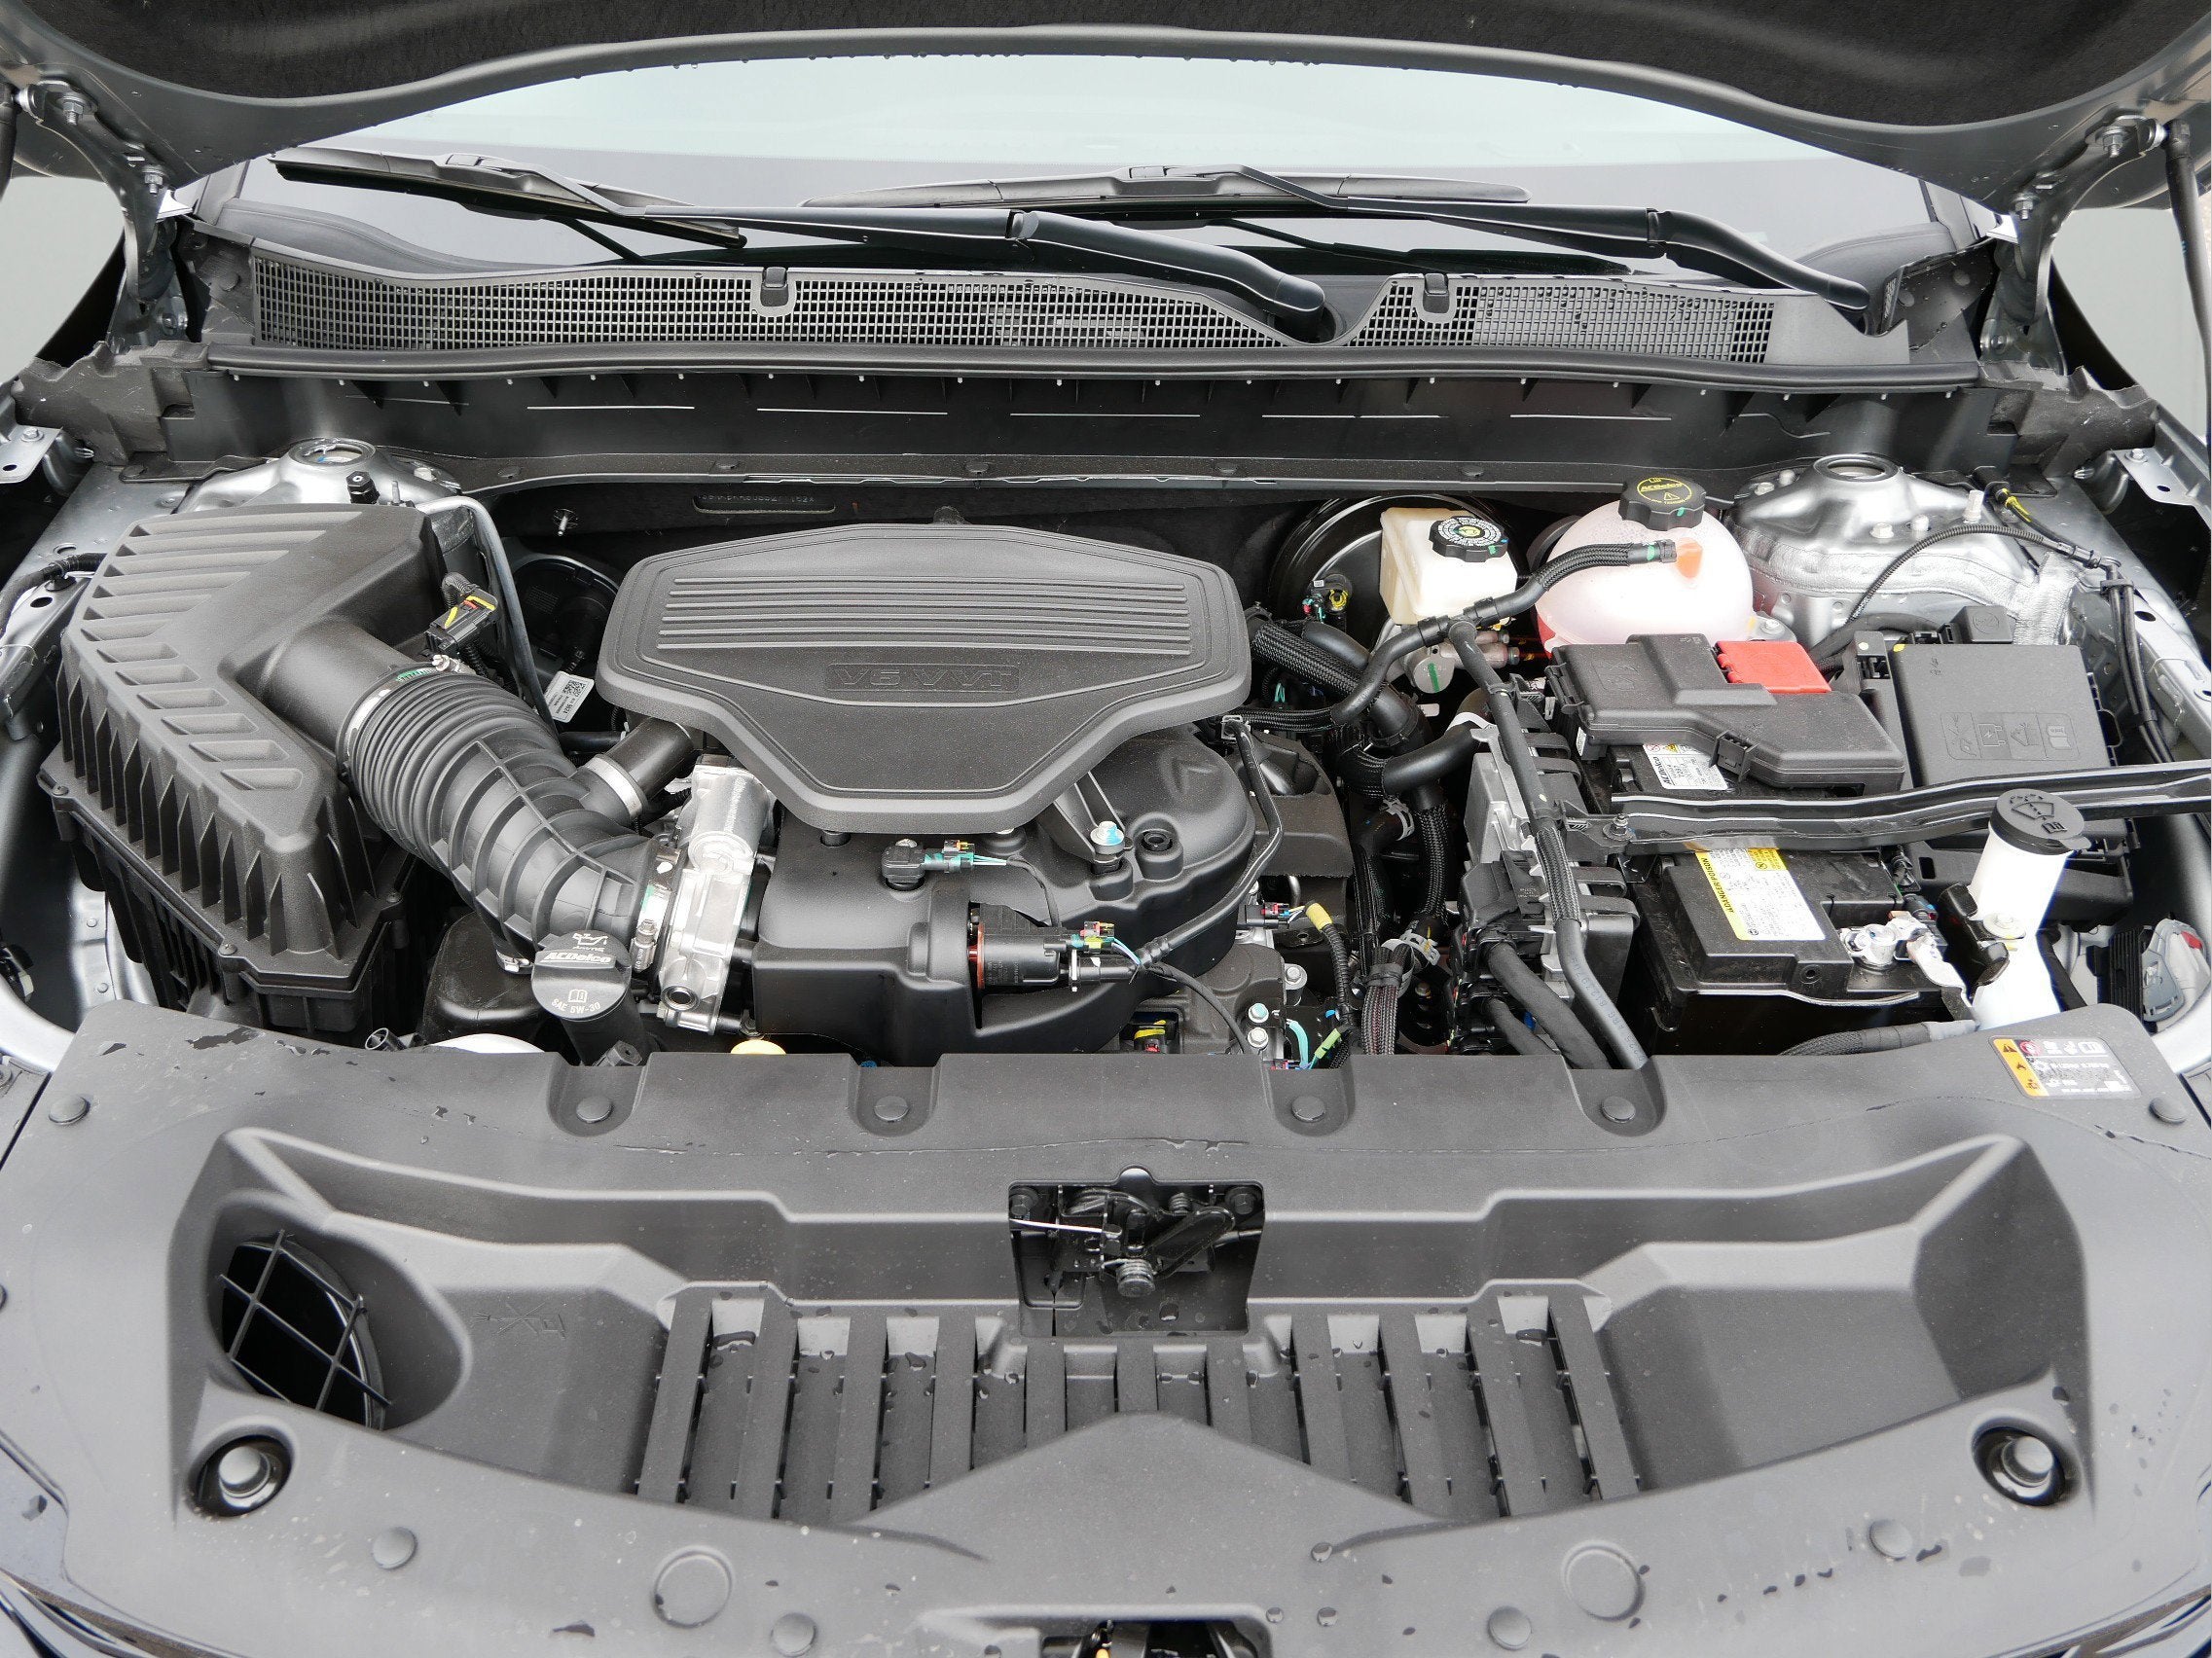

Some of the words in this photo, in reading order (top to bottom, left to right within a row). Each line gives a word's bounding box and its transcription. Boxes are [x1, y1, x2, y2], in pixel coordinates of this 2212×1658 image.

[835, 667, 900, 686] V6
[541, 952, 613, 964] ACDelco
[551, 998, 568, 1012] SAE
[569, 1001, 601, 1014] 5W-30
